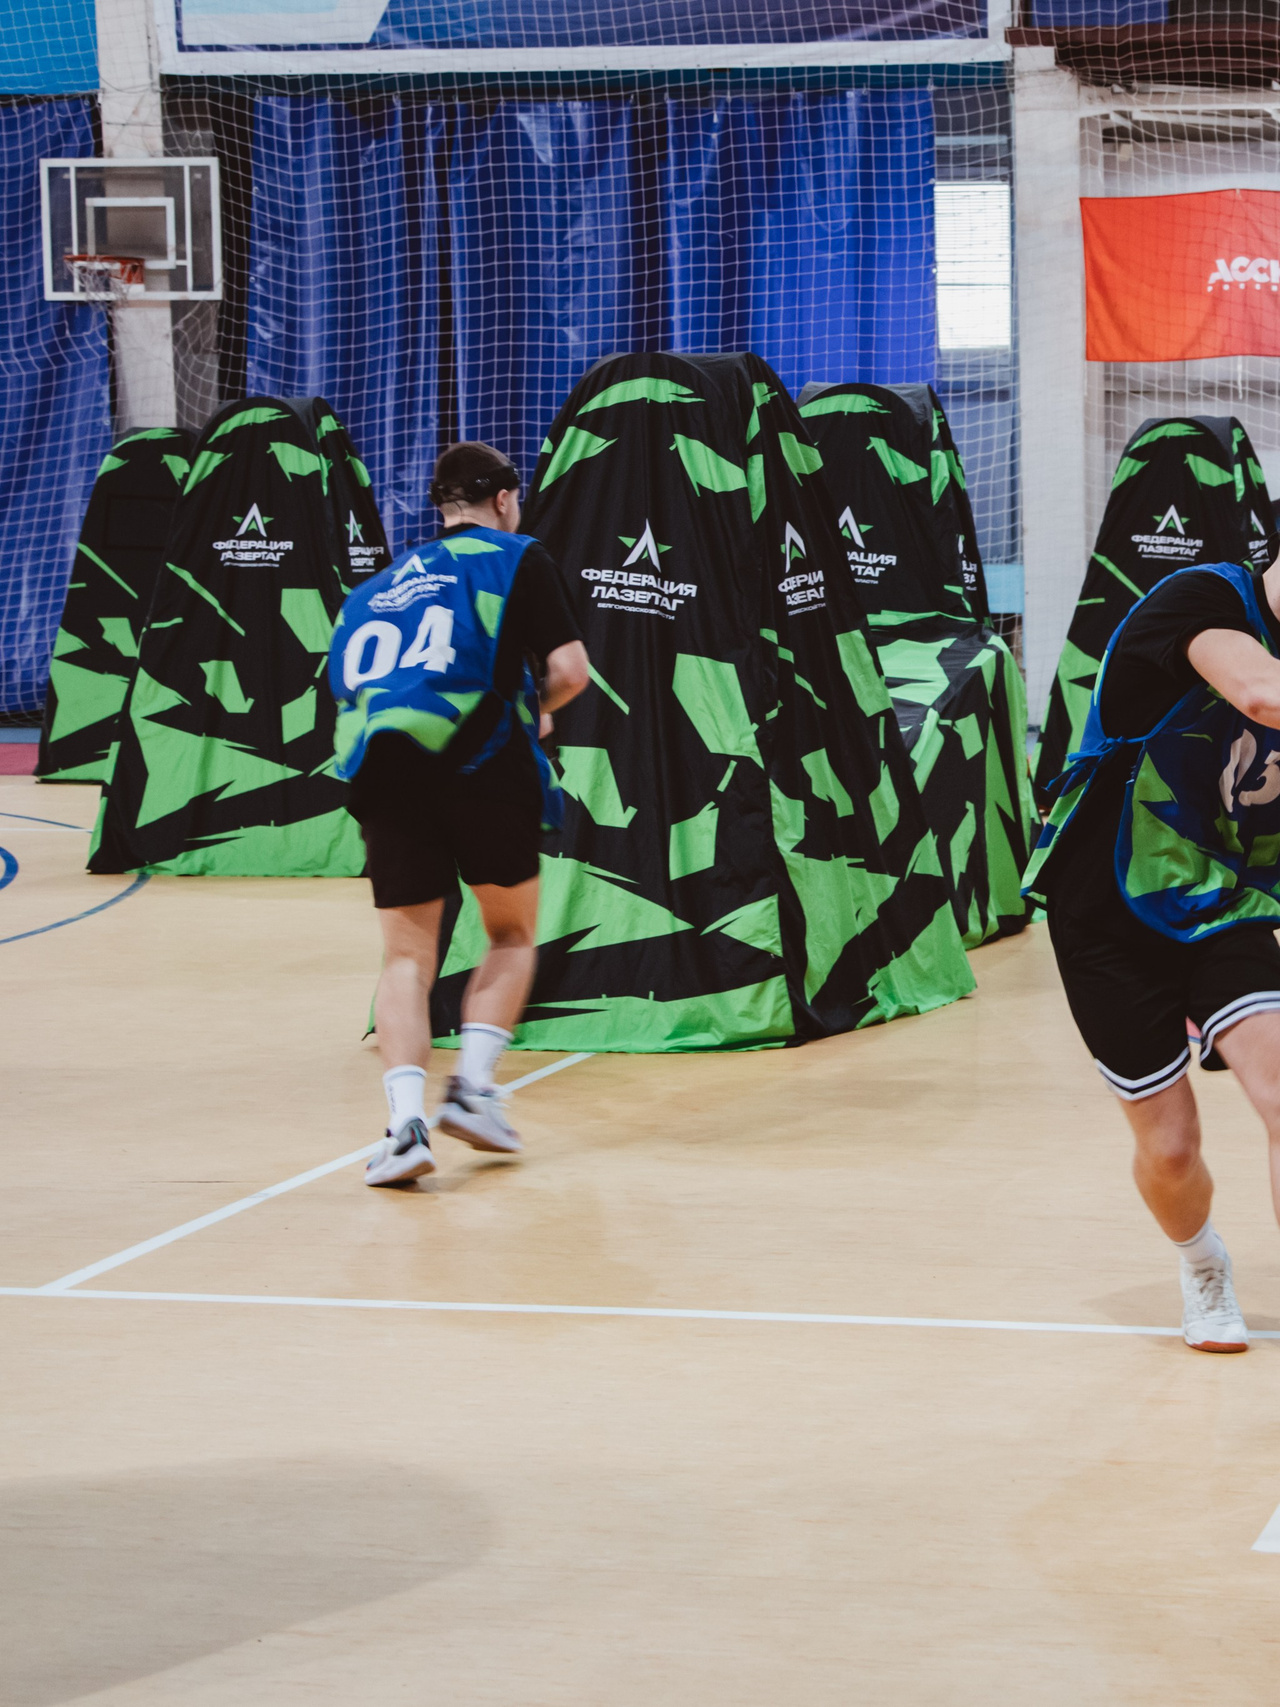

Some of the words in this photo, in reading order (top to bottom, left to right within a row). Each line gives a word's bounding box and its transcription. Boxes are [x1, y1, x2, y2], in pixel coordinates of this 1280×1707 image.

[847, 551, 897, 566] АЦИЯ
[581, 568, 698, 597] ФЕДЕРАЦИЯ
[591, 586, 685, 611] ЛАЗЕРТАГ
[343, 605, 456, 692] 04
